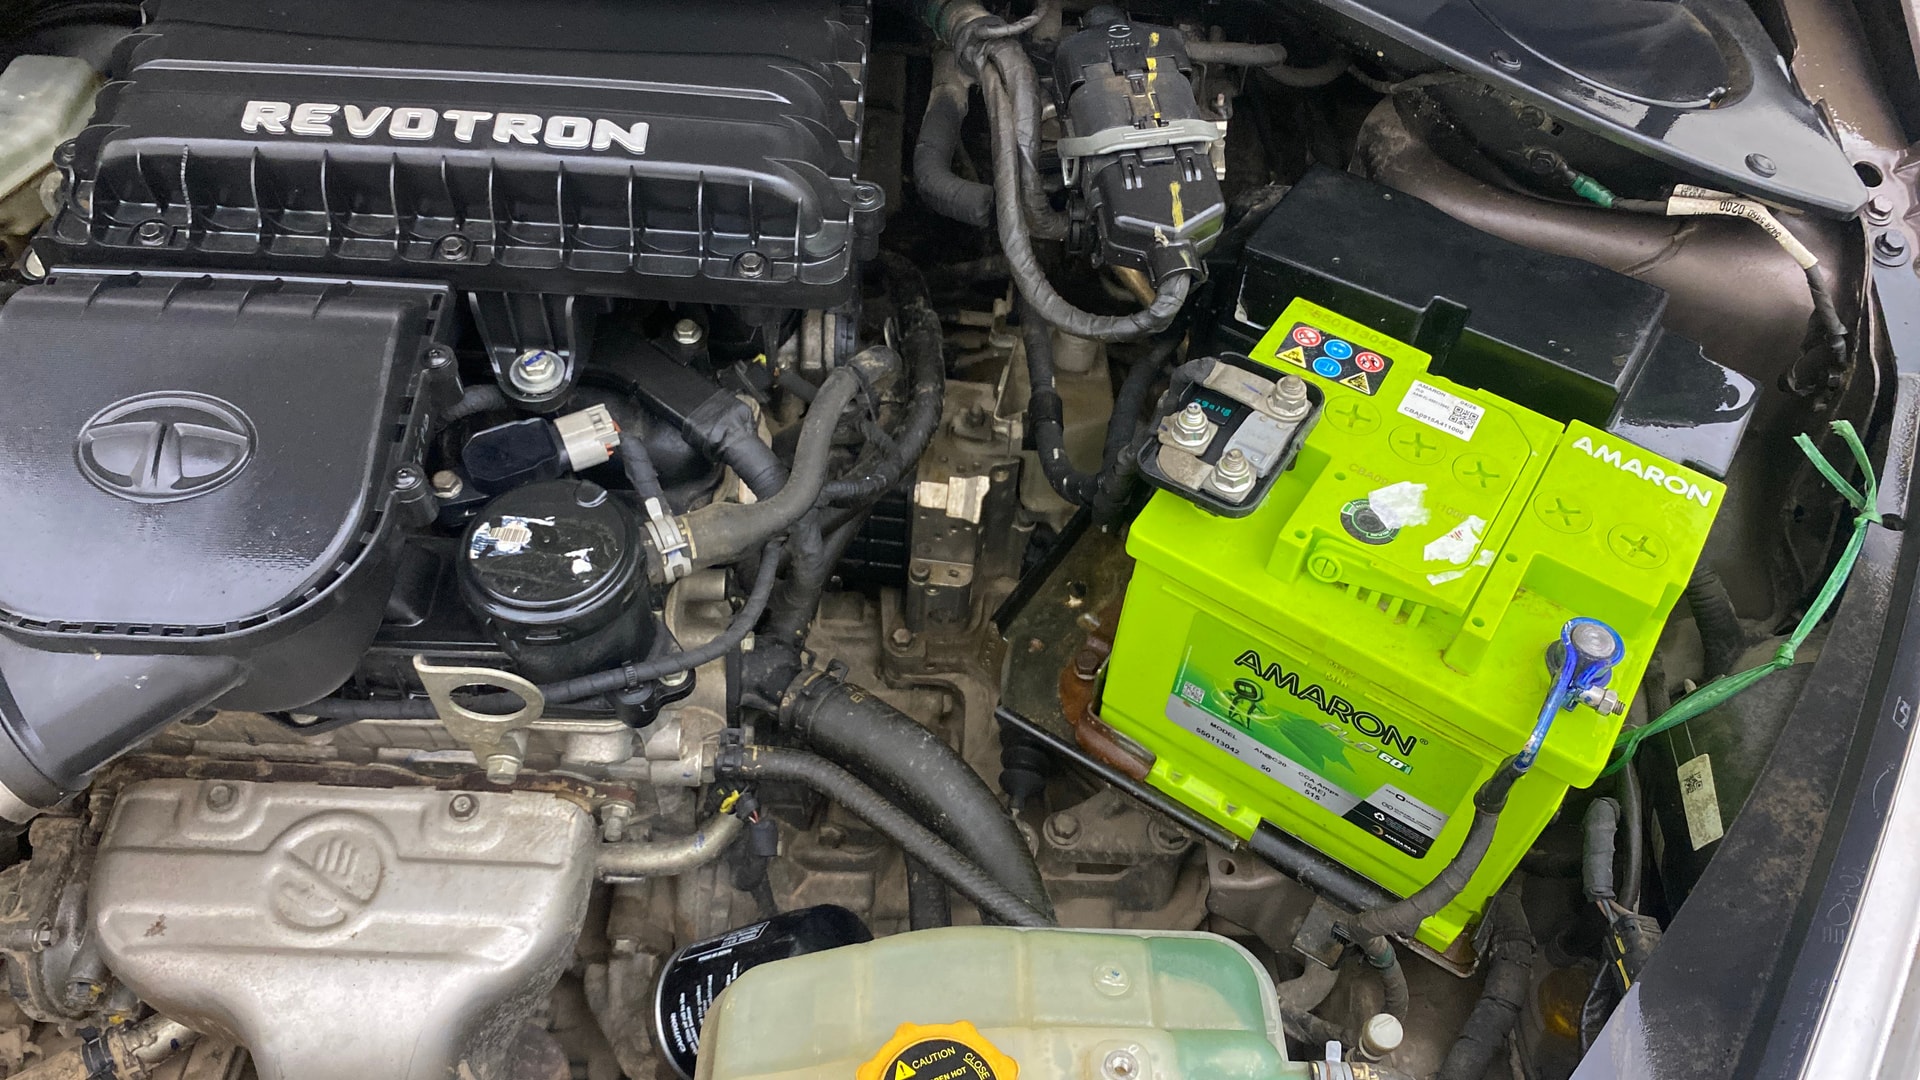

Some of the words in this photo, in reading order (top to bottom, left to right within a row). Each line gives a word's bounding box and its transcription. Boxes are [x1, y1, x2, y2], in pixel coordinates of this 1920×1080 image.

[240, 100, 650, 155] REVOTRON
[1720, 200, 1745, 214] 0200
[1418, 383, 1446, 397] AMARON
[1571, 436, 1713, 507] AMARON
[1233, 650, 1418, 756] AMARON
[1210, 721, 1237, 740] MODEL
[1196, 728, 1241, 755] 550113042
[1260, 764, 1271, 773] 50
[1298, 771, 1315, 783] CCA
[1303, 781, 1327, 797] (SAE)
[1304, 789, 1320, 801] 515
[912, 1046, 956, 1069] CAUTION
[964, 1052, 991, 1080] CLOSE
[950, 1066, 967, 1079] HOT
